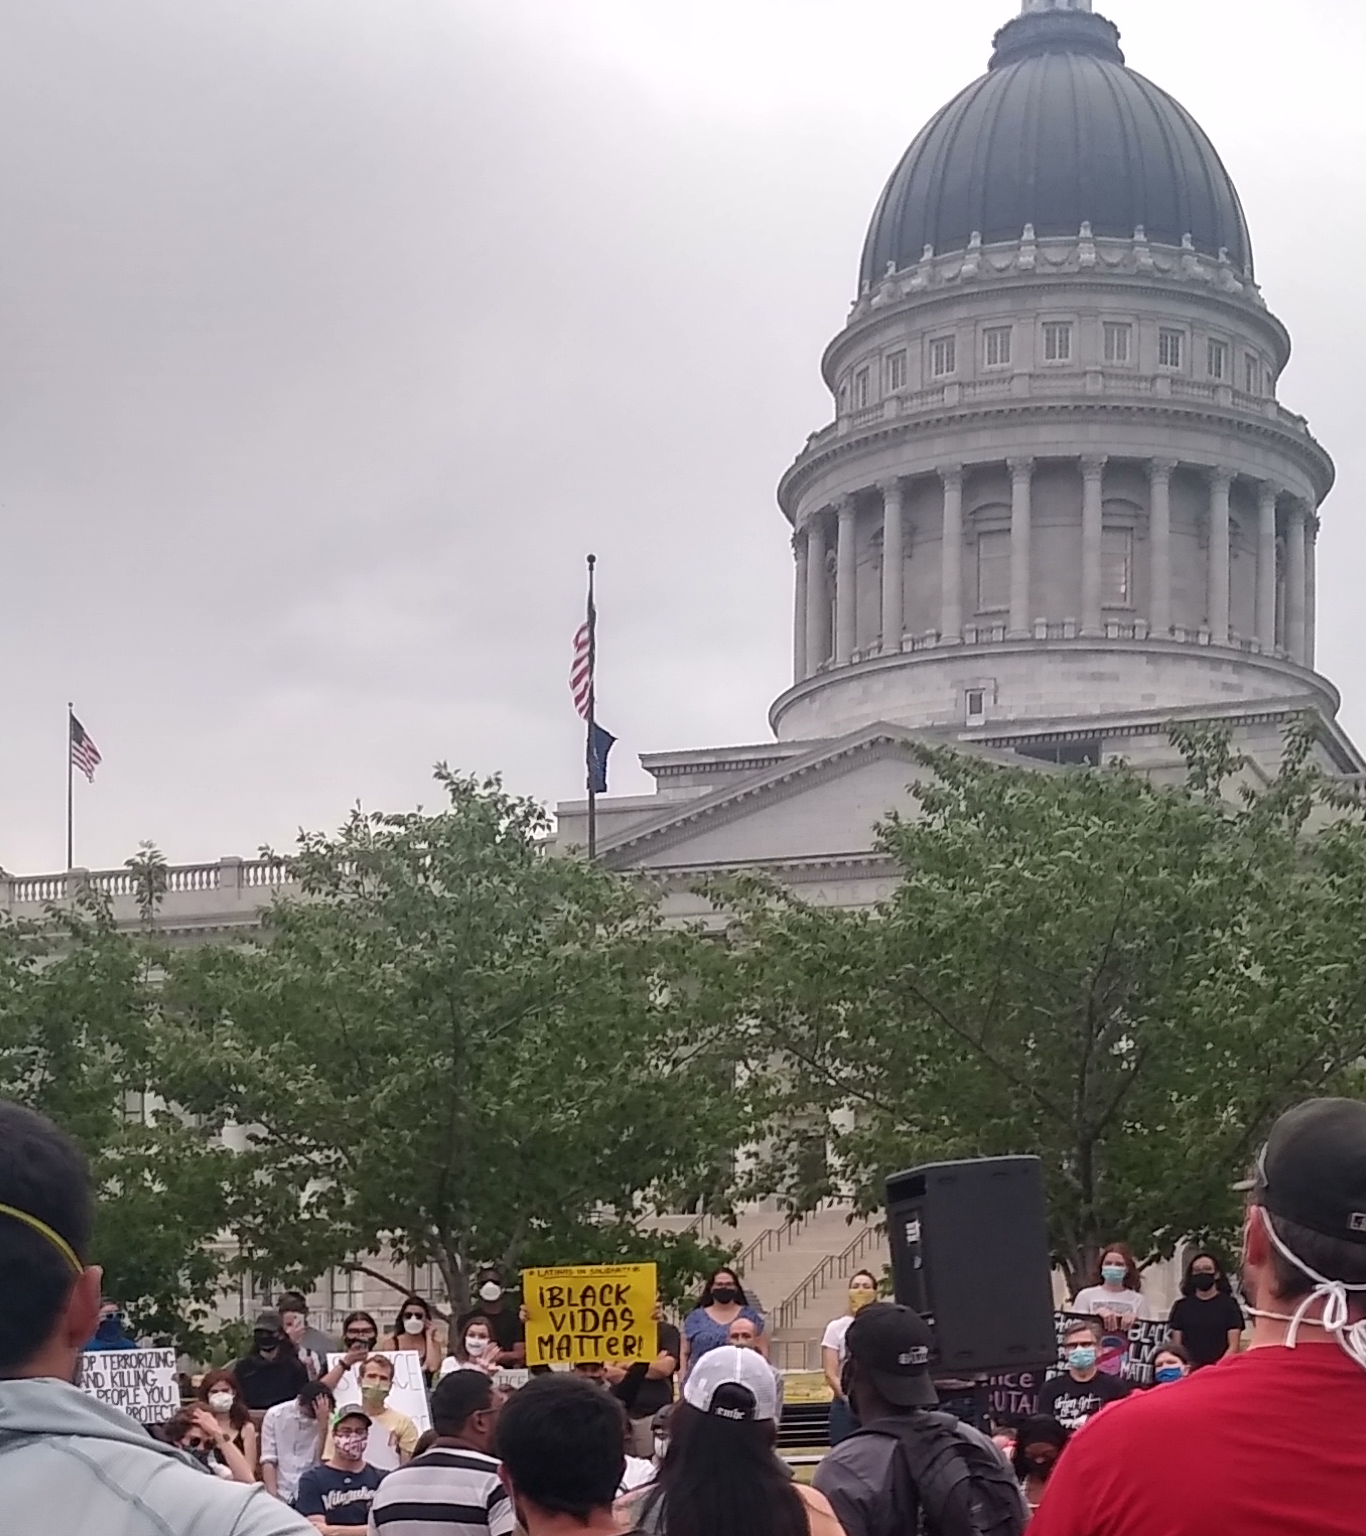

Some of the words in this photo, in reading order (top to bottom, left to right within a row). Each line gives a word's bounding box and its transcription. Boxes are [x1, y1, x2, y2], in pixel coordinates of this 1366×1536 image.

[549, 1307, 635, 1333] VIDAS
[1128, 1321, 1173, 1344] BLACK
[100, 1351, 175, 1370] TERRORIZING
[1129, 1342, 1156, 1363] LIV
[110, 1370, 158, 1388] KILLING
[97, 1388, 141, 1406] PEOPLE
[144, 1386, 172, 1403] YOU
[125, 1404, 177, 1423] PROTECT
